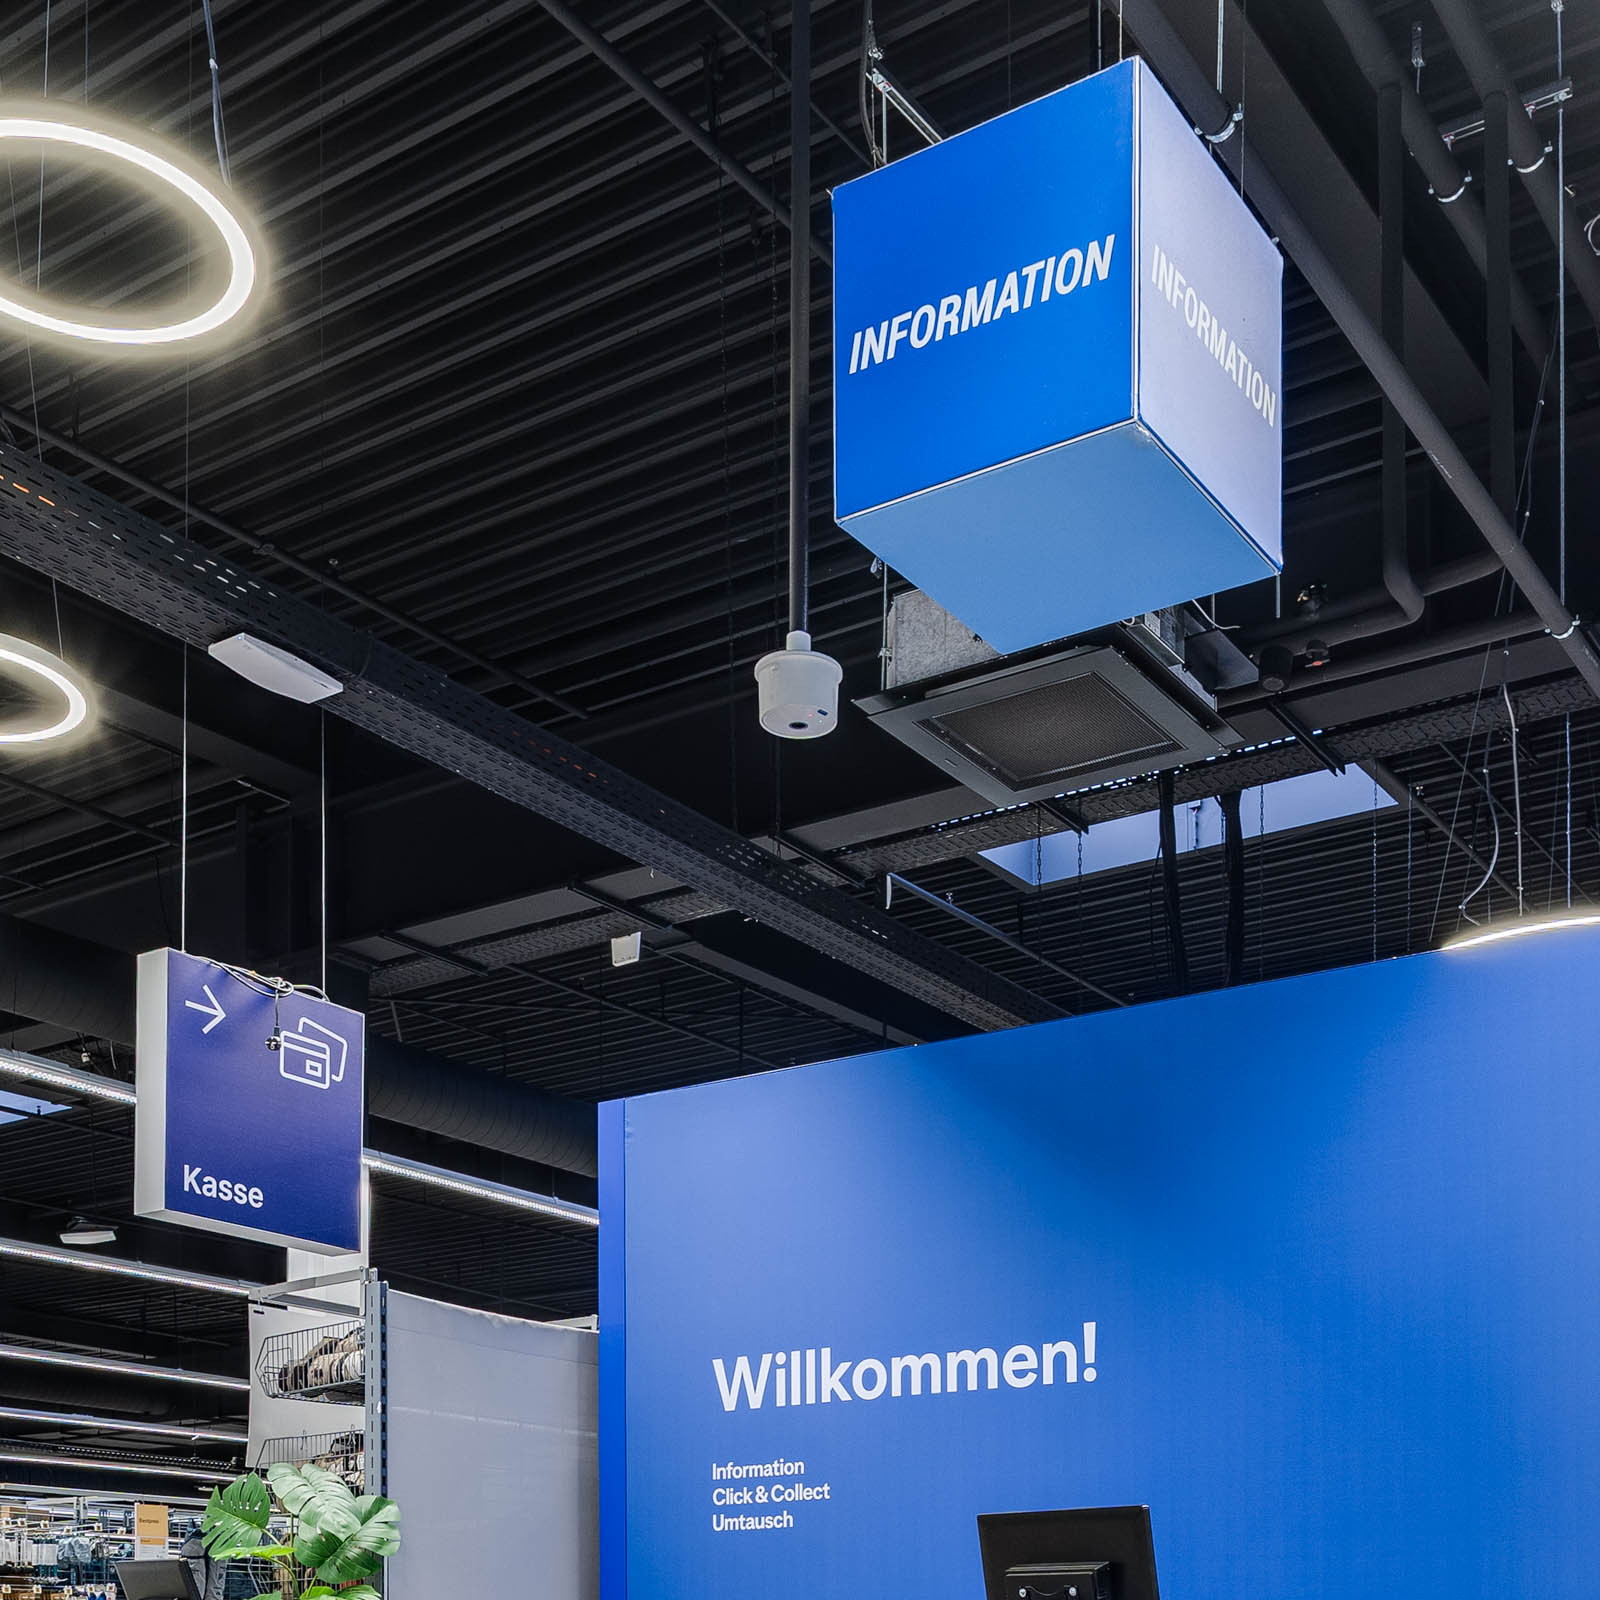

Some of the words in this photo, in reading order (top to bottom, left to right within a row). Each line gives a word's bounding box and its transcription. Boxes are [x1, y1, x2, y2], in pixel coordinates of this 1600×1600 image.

[848, 234, 1116, 375] INFORMATION
[1151, 244, 1278, 428] INFORMATION
[183, 1164, 264, 1209] Kasse
[712, 1321, 1098, 1412] Willkommen!
[712, 1457, 805, 1481] Information
[712, 1487, 754, 1507] Click
[755, 1485, 769, 1503] &
[770, 1482, 831, 1503] Collect
[712, 1510, 794, 1532] Umtausch
